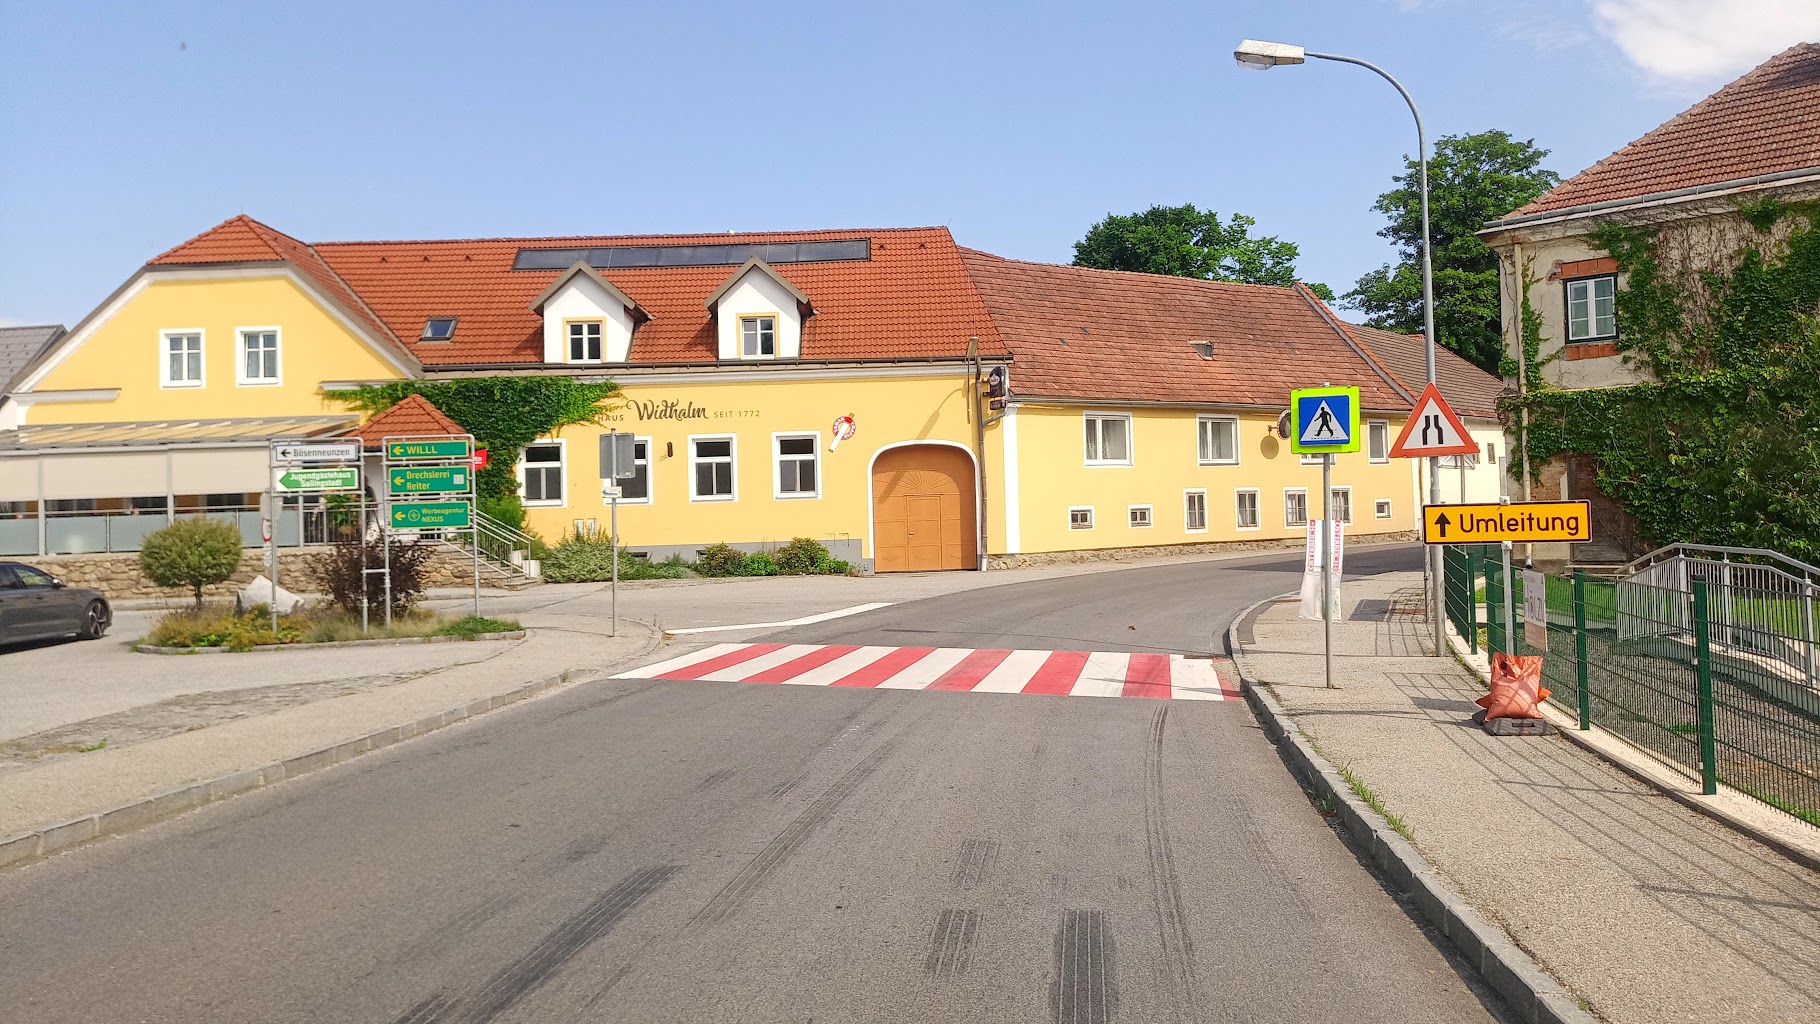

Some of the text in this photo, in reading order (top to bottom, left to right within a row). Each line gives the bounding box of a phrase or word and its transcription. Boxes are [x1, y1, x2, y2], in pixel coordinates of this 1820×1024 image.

[625, 398, 709, 421] Widhalm
[713, 410, 733, 418] SEIT
[738, 409, 760, 417] 1772
[293, 448, 350, 457] Bösenneunzen
[406, 445, 438, 454] WILLL
[406, 470, 450, 479] Drechslerei
[406, 481, 430, 490] Reiter
[421, 507, 465, 515] Werbeagentur
[421, 515, 444, 523] NEXUS
[1459, 512, 1580, 536] Umleitung
